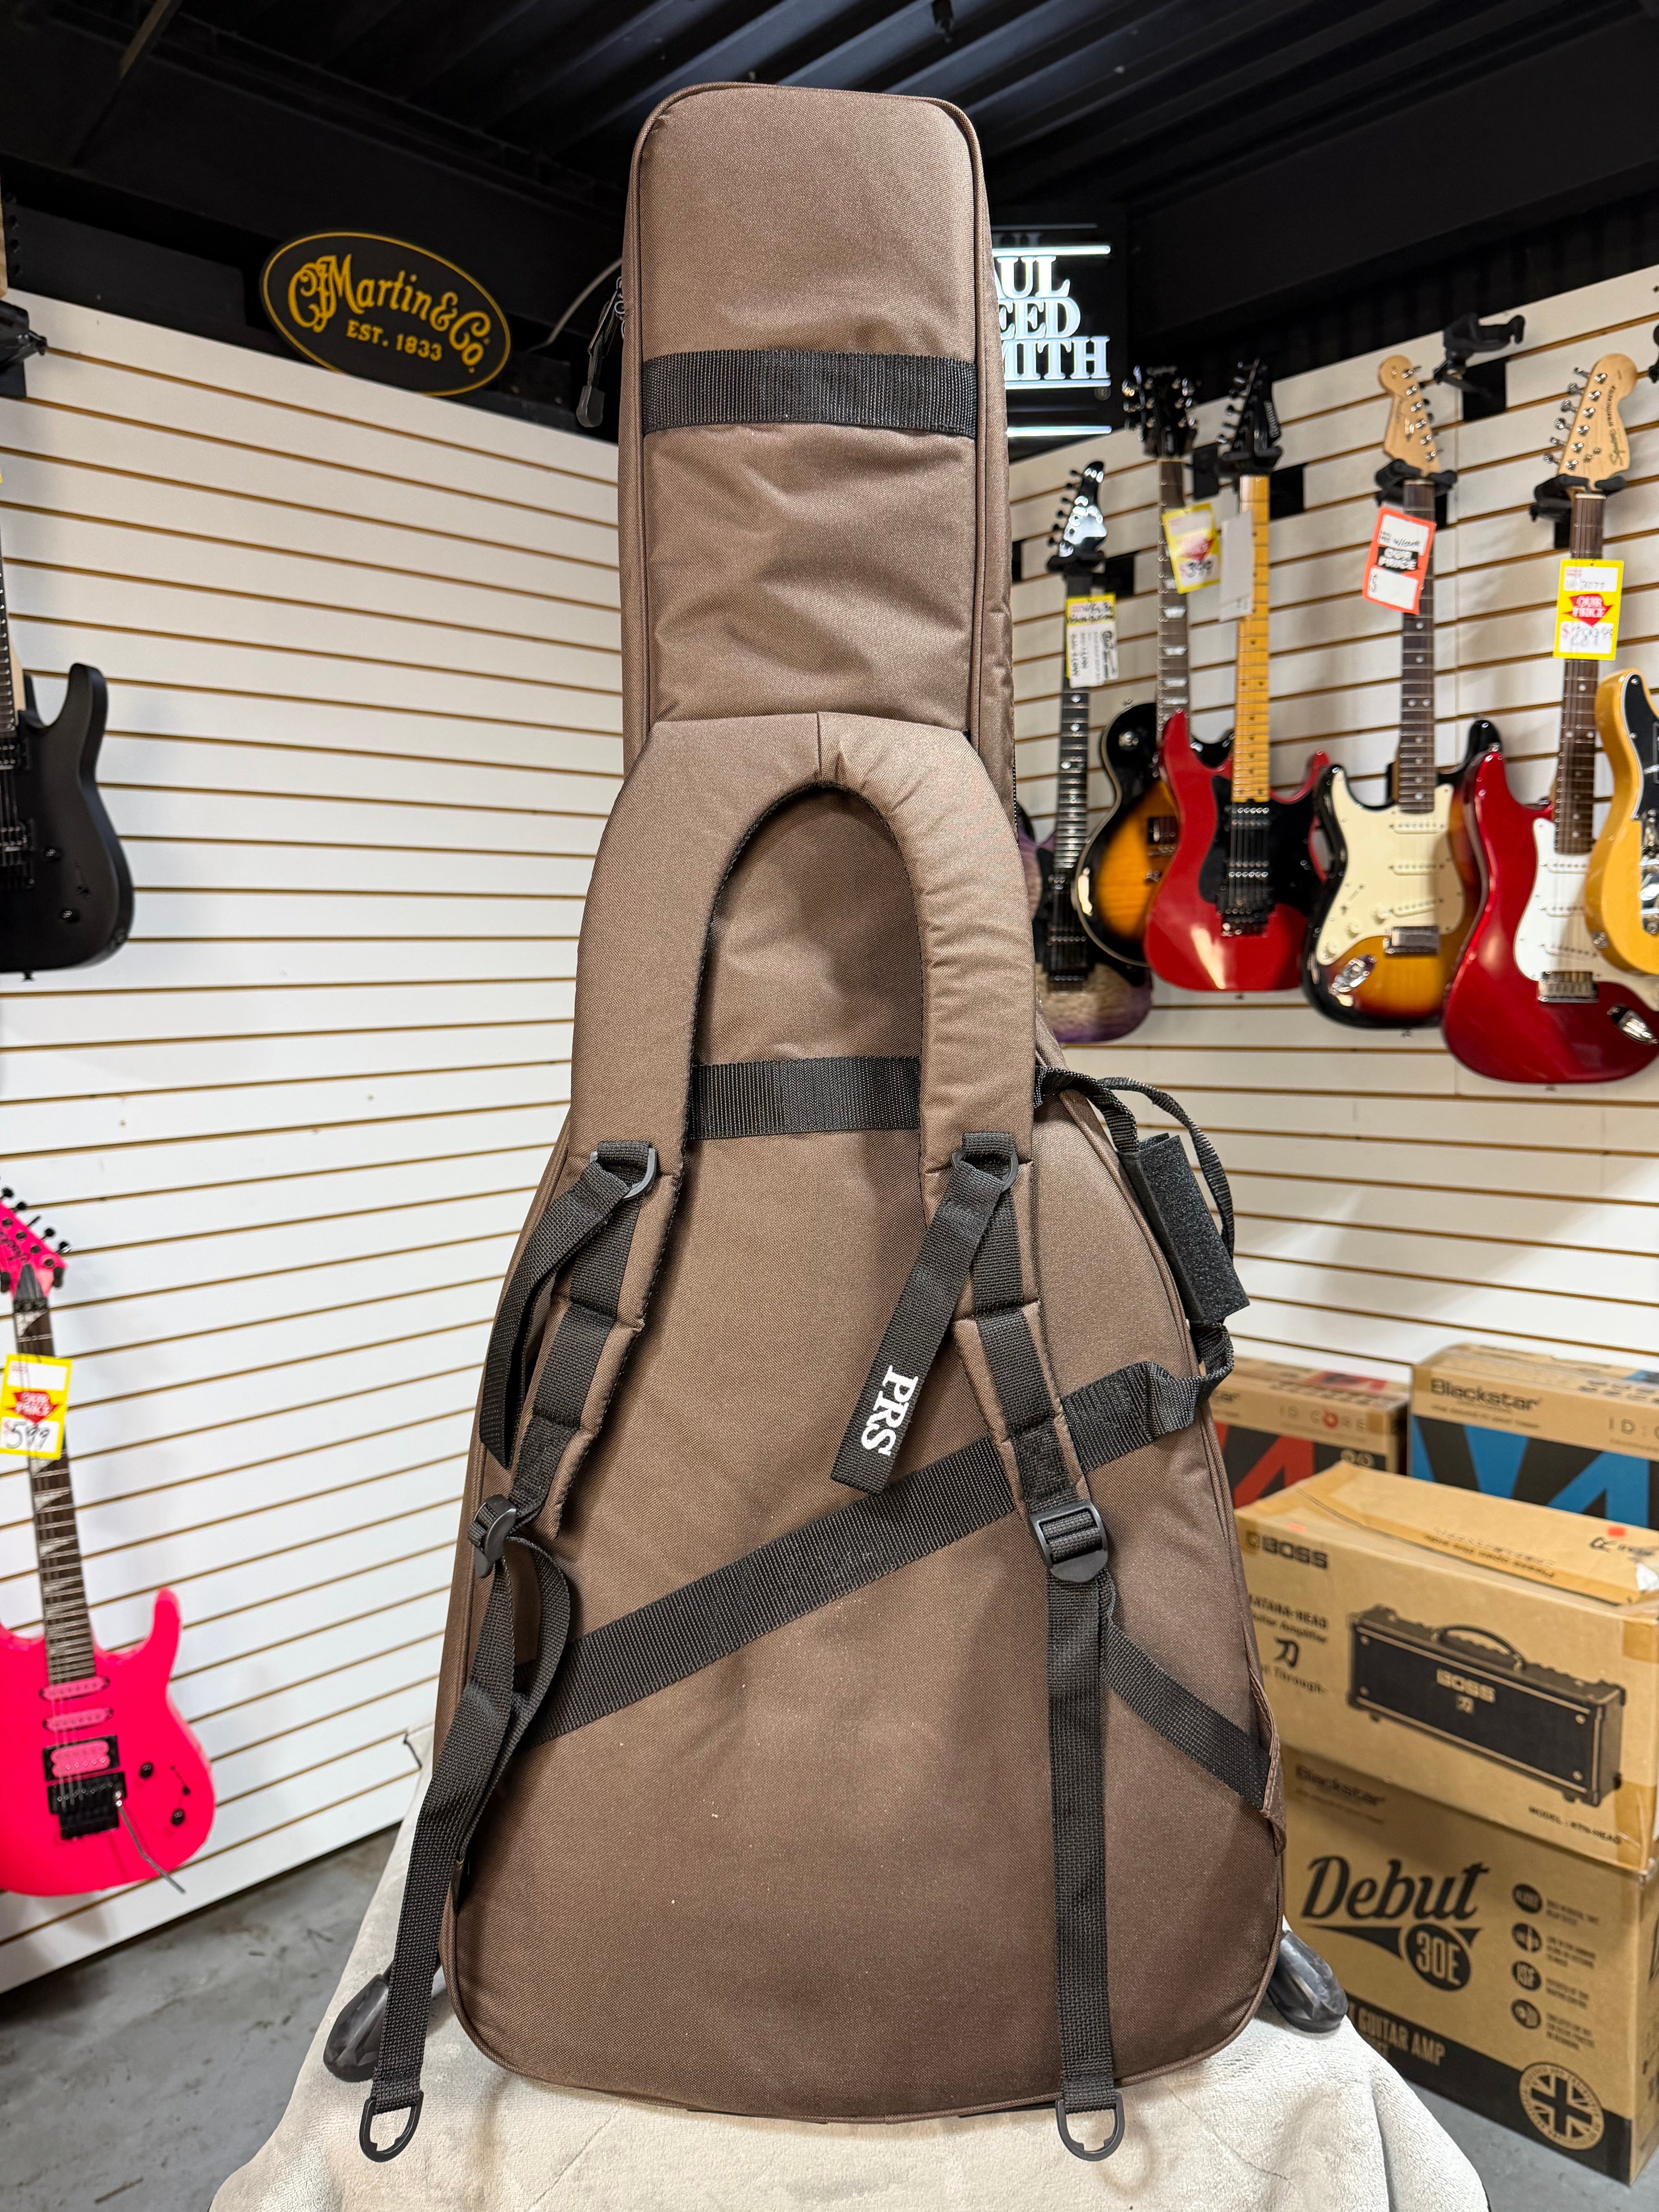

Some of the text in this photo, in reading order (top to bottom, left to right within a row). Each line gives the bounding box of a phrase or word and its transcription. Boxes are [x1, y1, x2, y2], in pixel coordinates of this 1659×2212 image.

[346, 319, 443, 362] EST. 1833
[1377, 556, 1418, 570] PRICE
[1384, 546, 1413, 561] OUR
[1571, 607, 1607, 618] PRICE
[1576, 595, 1603, 608] OUR
[861, 1365, 919, 1456] PRS
[1431, 1378, 1540, 1412] Blackstar
[1262, 1535, 1328, 1570] BOSS
[1247, 1592, 1328, 1628] ATANA-HEAD
[1436, 1669, 1496, 1703] BOSS
[1301, 1856, 1490, 1920] Debut
[1416, 1930, 1462, 1986] 30E
[1358, 2007, 1409, 2052] GUITAR
[1410, 2032, 1446, 2066] AMP
